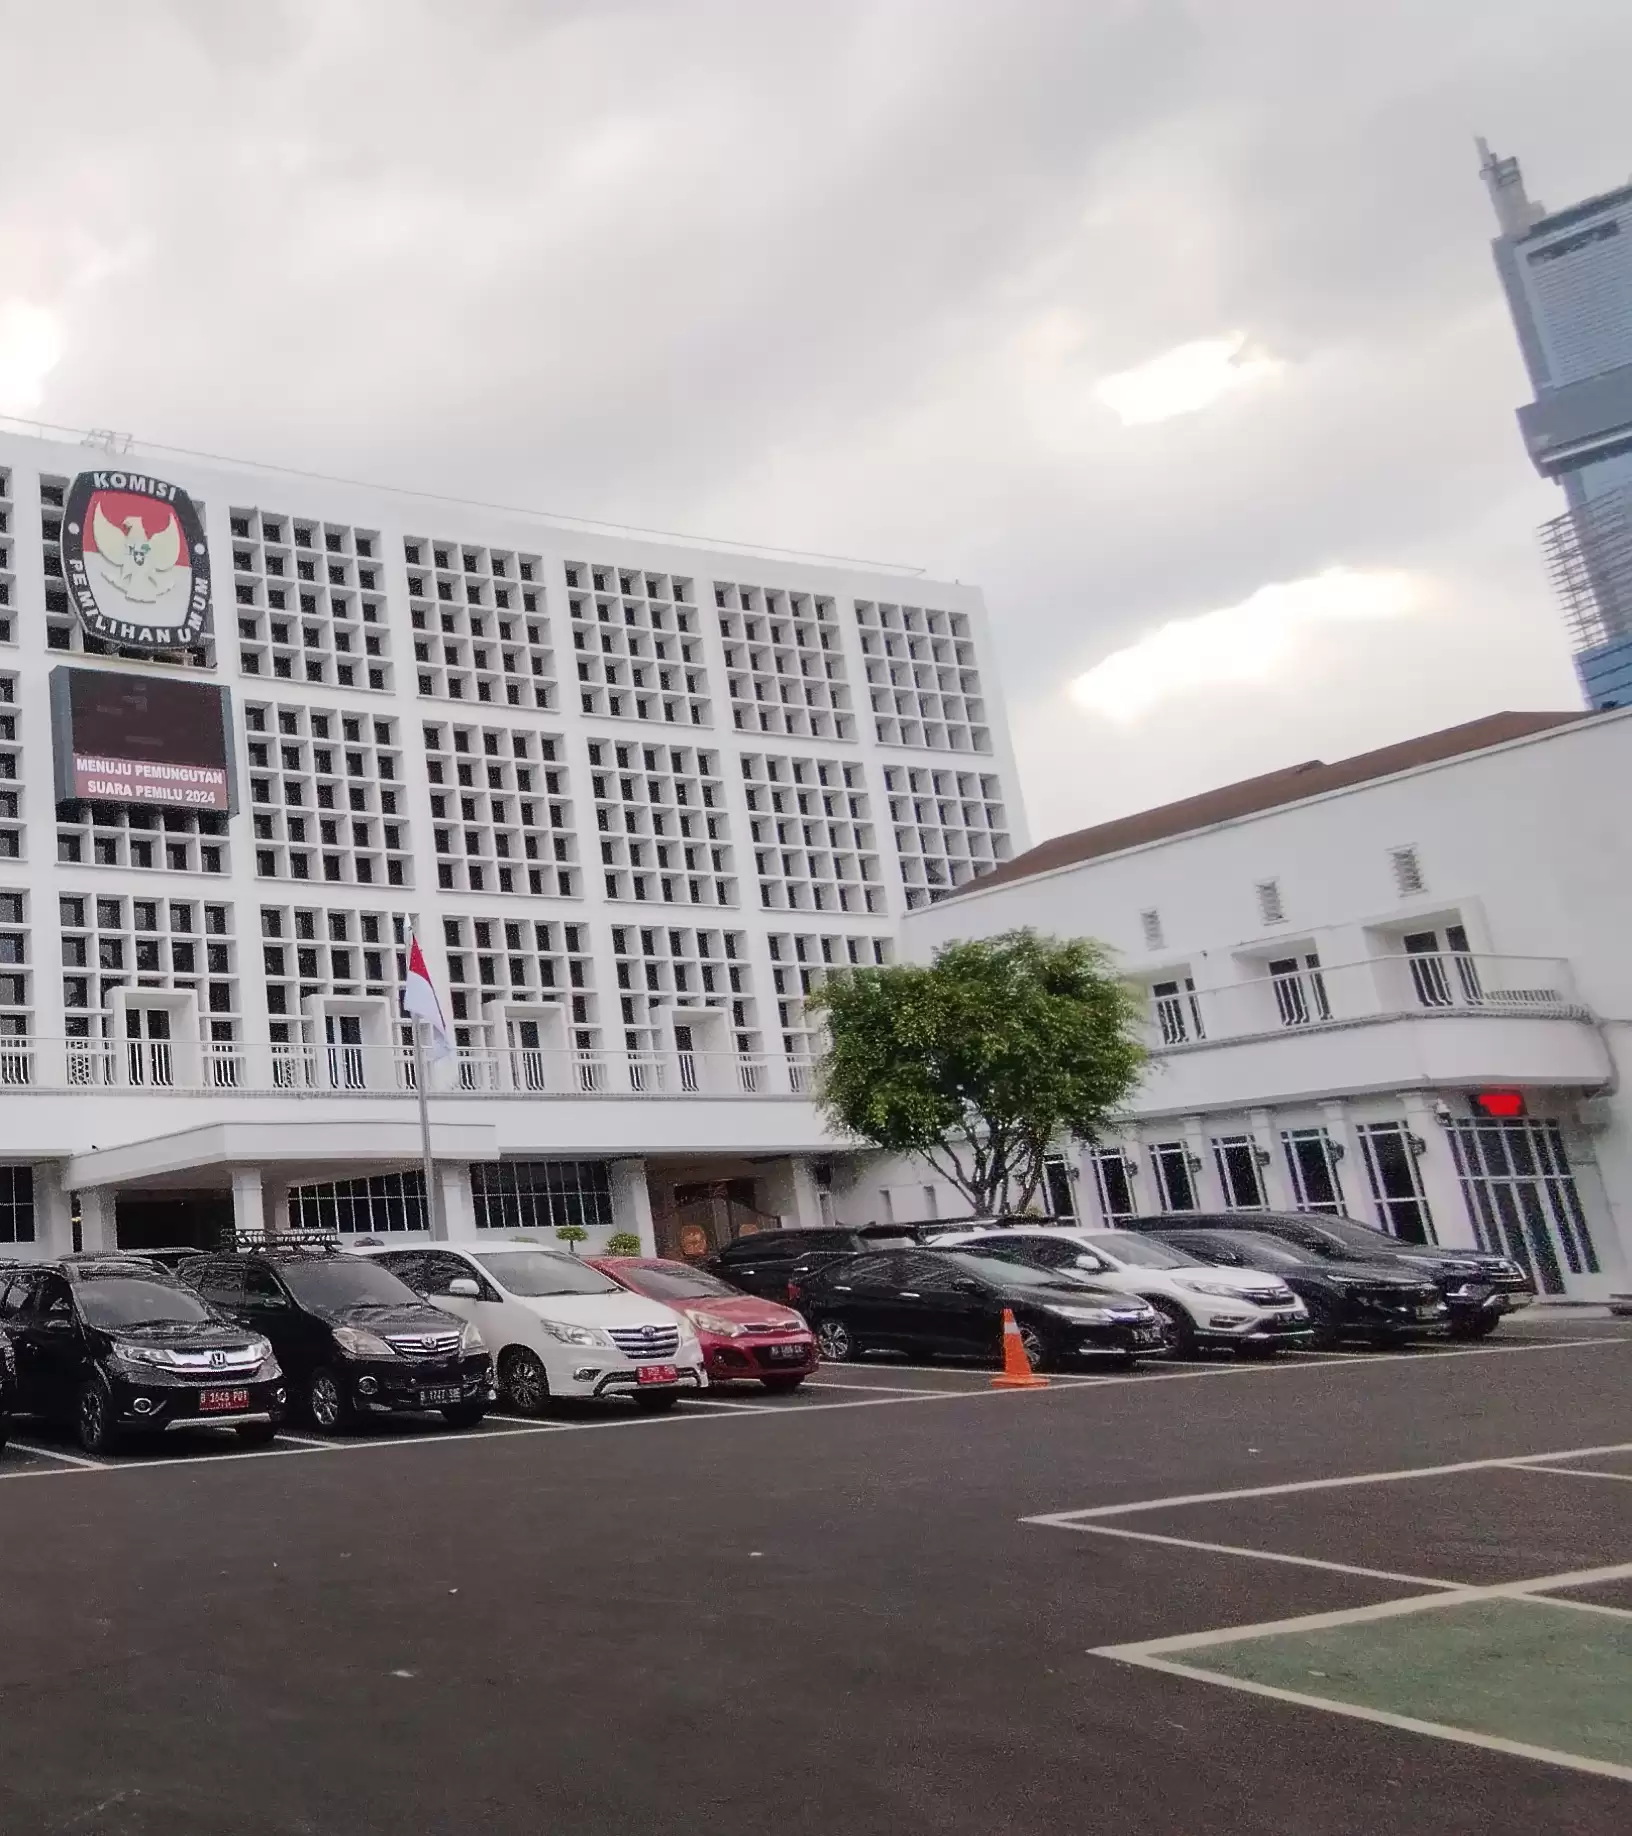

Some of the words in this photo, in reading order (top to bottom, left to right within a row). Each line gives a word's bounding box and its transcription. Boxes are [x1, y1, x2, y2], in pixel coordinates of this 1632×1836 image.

[93, 472, 176, 501] KOMISI
[69, 559, 171, 643] PEMILIHAN
[177, 577, 208, 643] UMUM
[76, 758, 132, 776] MENUJU
[135, 764, 223, 785] PEMUNGUTAN
[87, 780, 132, 797] SUARA
[135, 785, 183, 801] PEMILU
[185, 789, 216, 804] 2024
